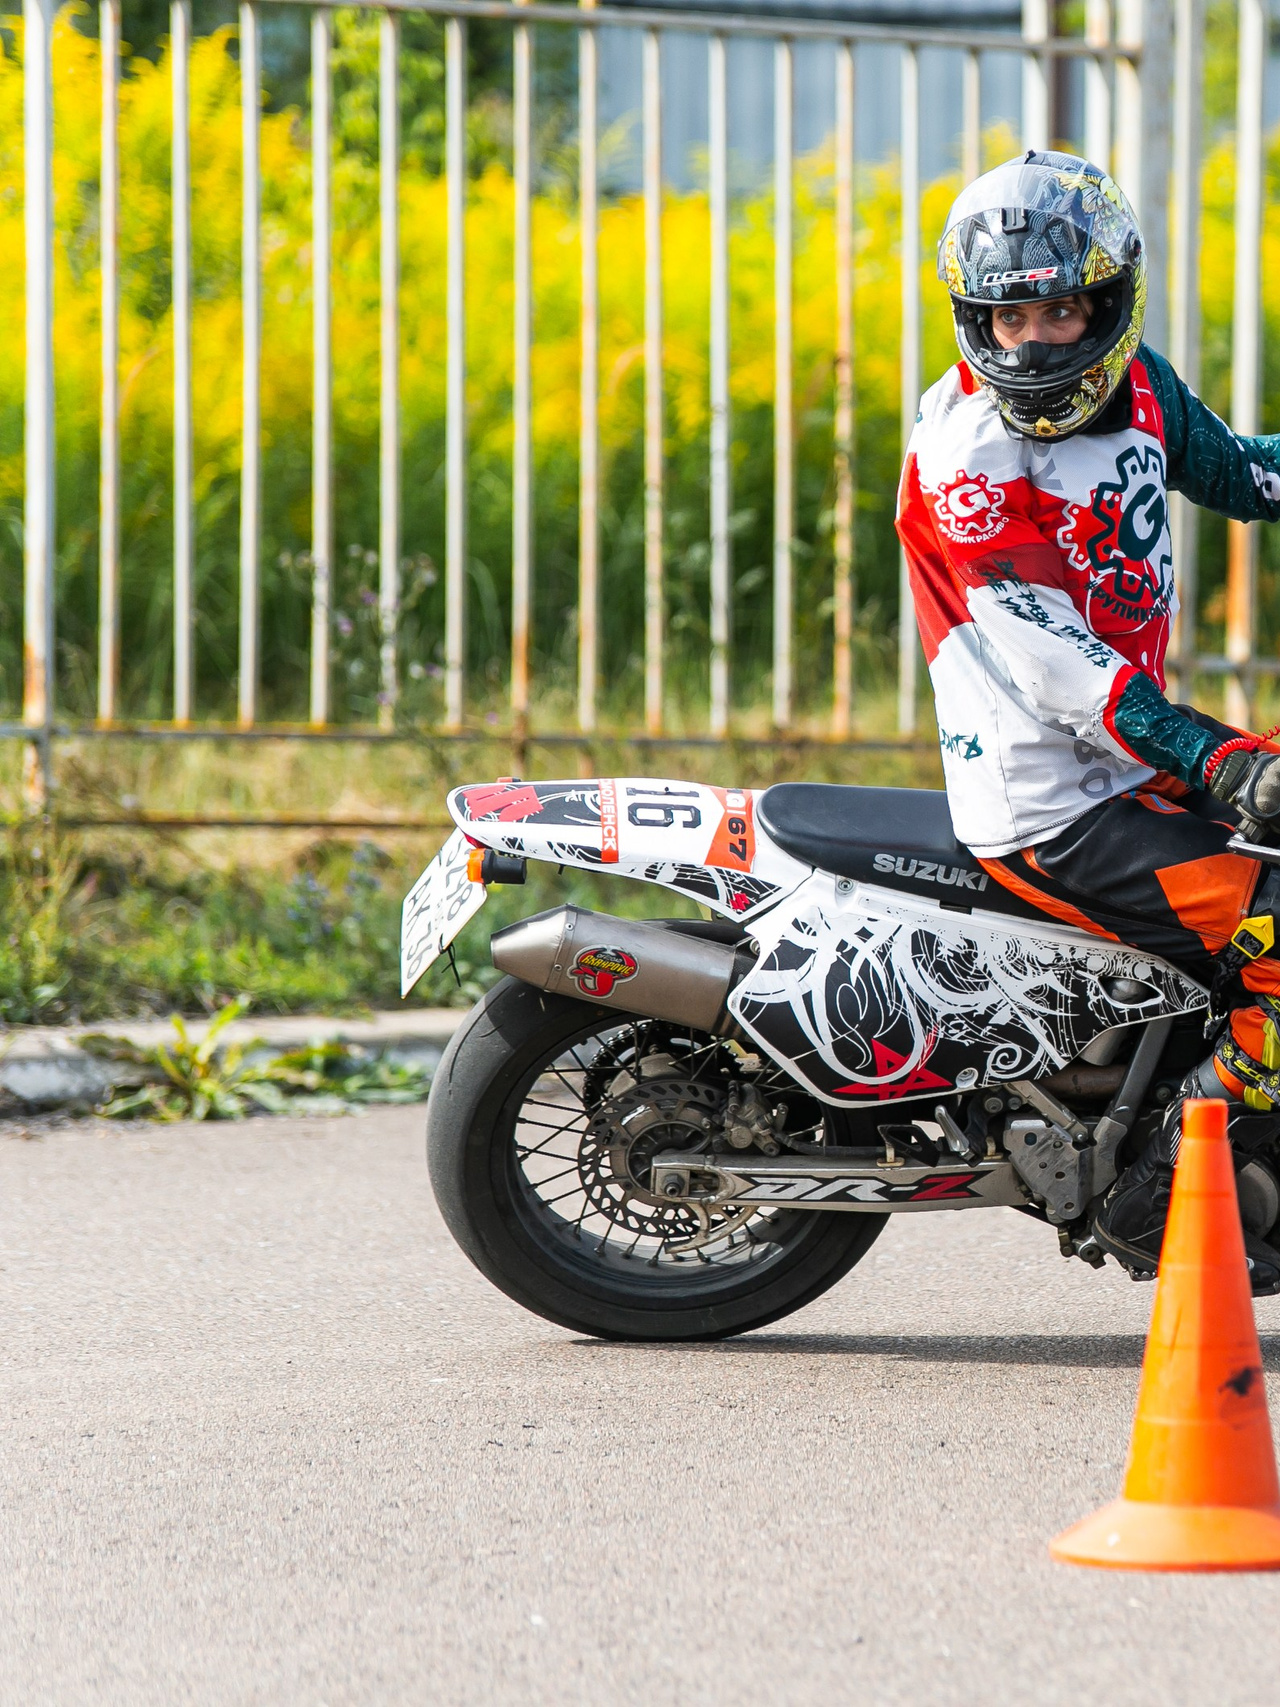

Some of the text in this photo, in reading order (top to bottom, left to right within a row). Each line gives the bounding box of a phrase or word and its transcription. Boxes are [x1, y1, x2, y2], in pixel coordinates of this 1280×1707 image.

[983, 266, 1058, 287] LS2
[625, 787, 702, 829] 16
[728, 816, 747, 862] 67
[873, 853, 989, 892] SUZUKI
[737, 1174, 976, 1201] DR-Z
